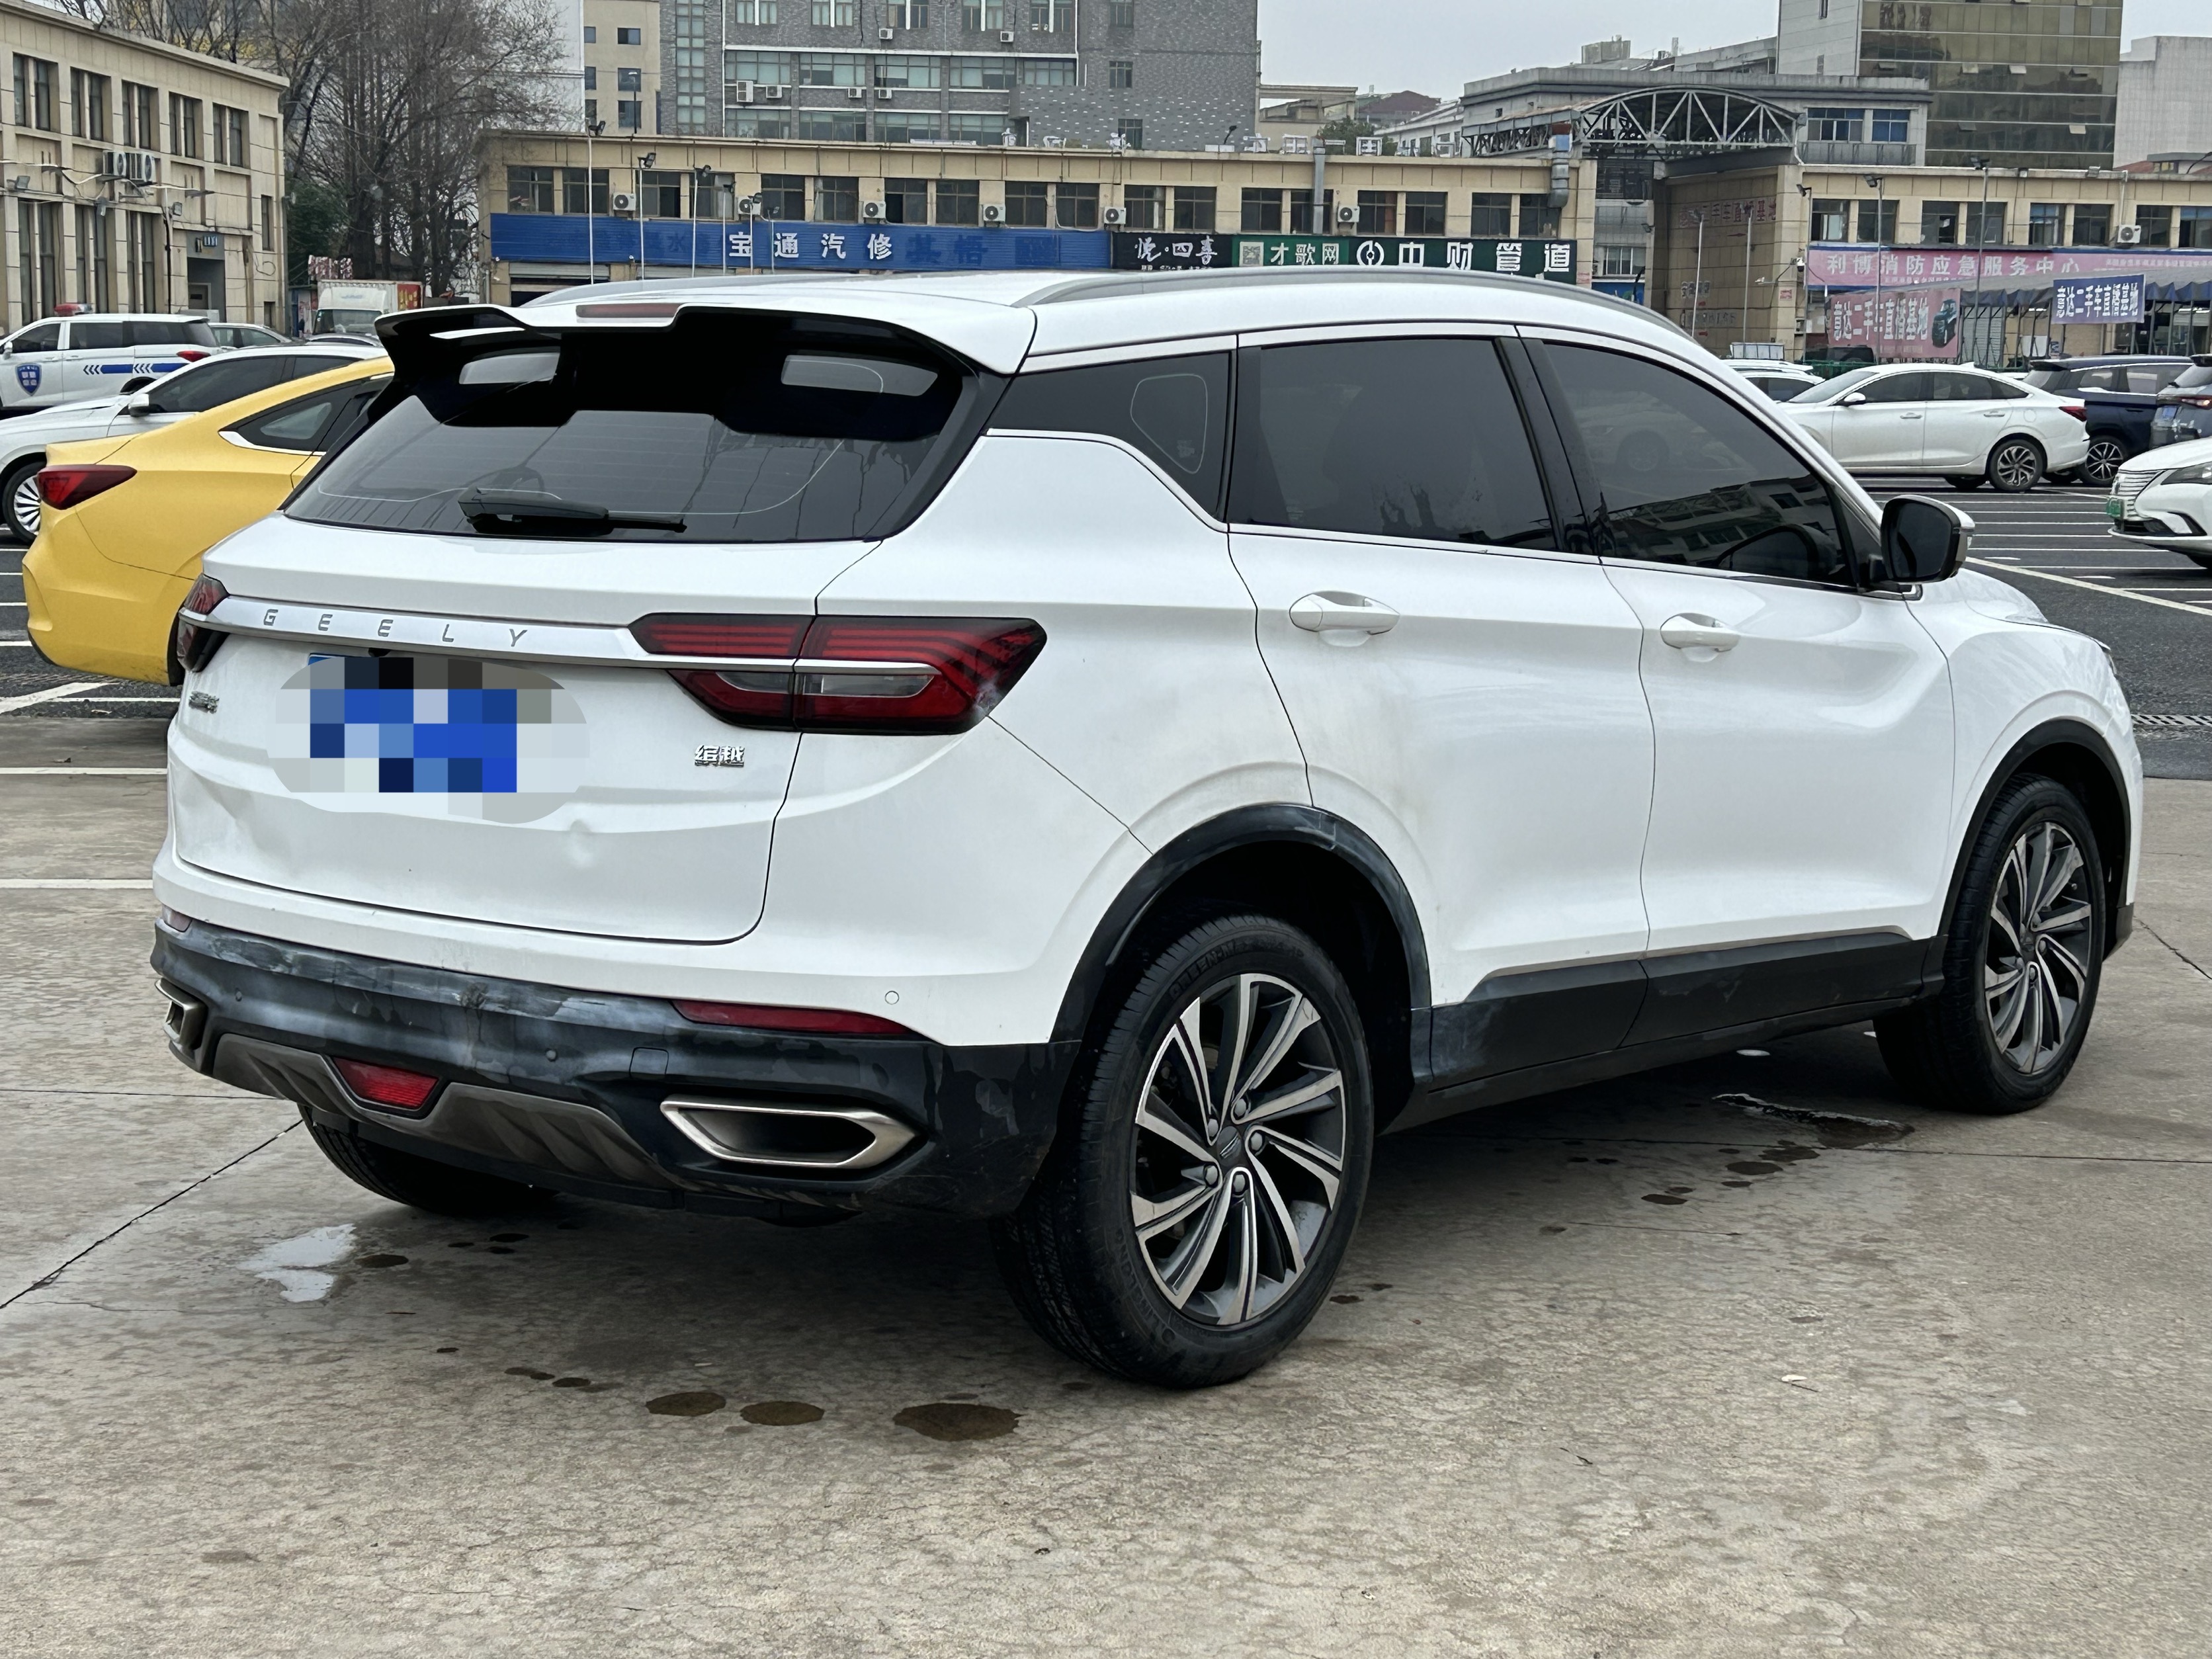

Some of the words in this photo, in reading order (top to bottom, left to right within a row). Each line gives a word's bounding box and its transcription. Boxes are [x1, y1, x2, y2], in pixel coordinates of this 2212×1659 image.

[729, 231, 892, 261] 宝通汽修
[1270, 243, 1340, 266] 才歌网
[1398, 241, 1570, 272] 中财管道
[1827, 255, 2079, 276] 利博消防应急服务中心
[263, 609, 528, 648] GEELY
[694, 745, 745, 767] 缤越
